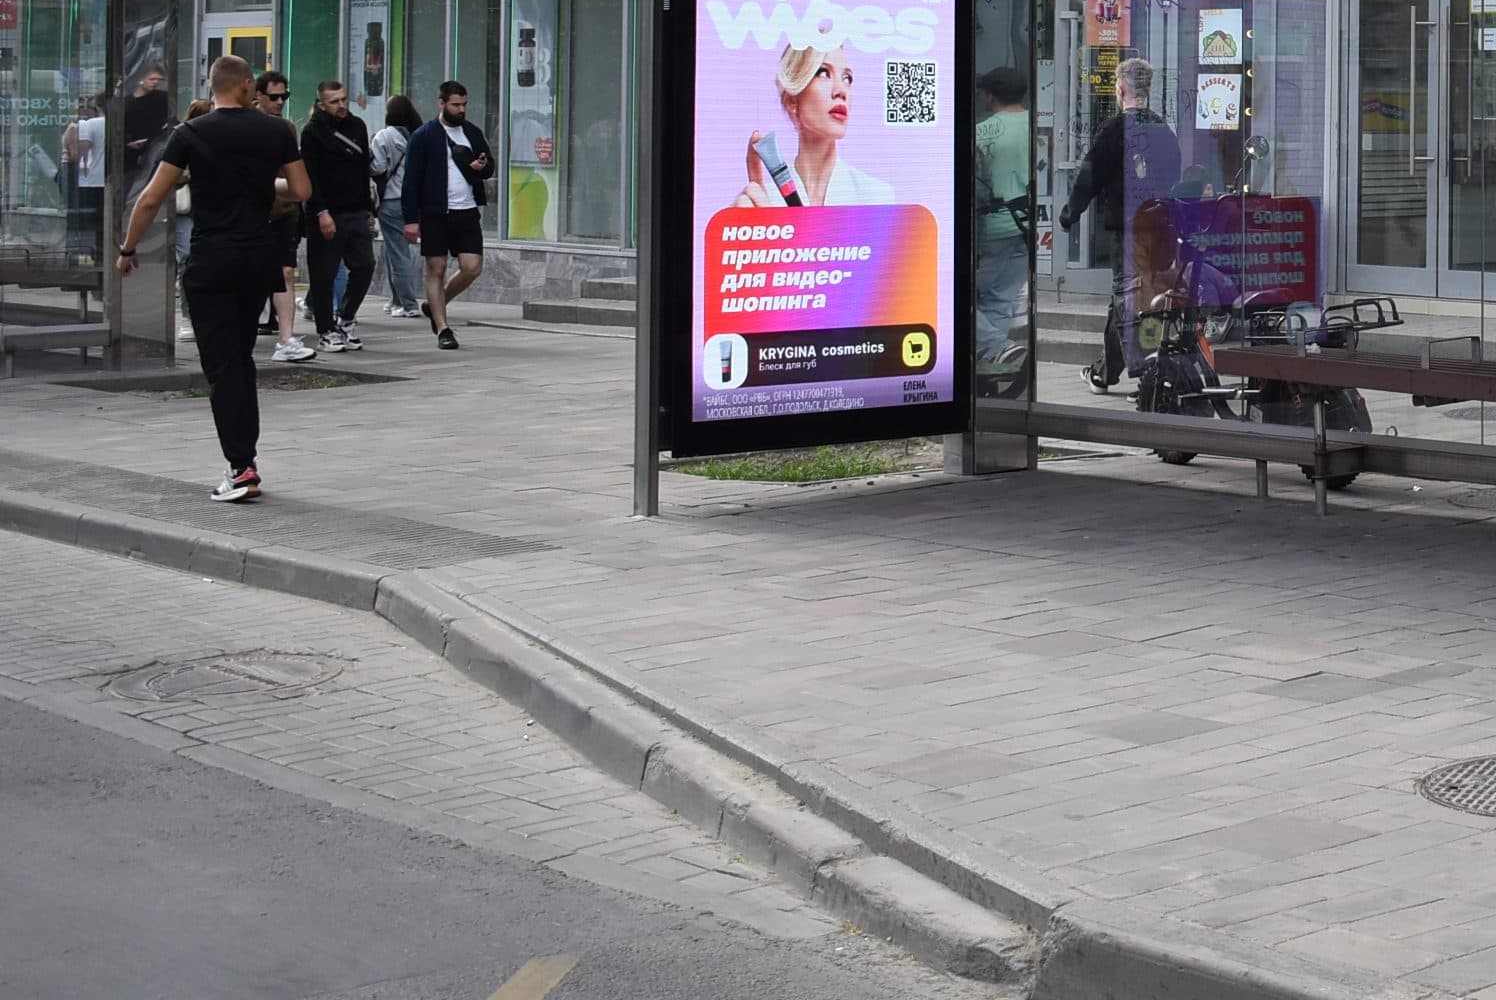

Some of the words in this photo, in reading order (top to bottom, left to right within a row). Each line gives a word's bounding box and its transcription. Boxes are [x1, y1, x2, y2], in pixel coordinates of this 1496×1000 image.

[1201, 78, 1237, 92] DESSERTS
[721, 224, 795, 241] новое
[721, 245, 872, 270] приложение
[720, 272, 767, 293] для
[772, 269, 852, 290] видео-
[721, 293, 827, 313] шопинга
[759, 347, 817, 361] KRYGINA
[821, 342, 885, 357] cosmetics
[759, 362, 784, 371] Блеск
[785, 362, 801, 370] для
[802, 359, 817, 370] губ
[903, 381, 927, 391] ЕЛЕНА
[903, 391, 938, 403] КРЫГИНА
